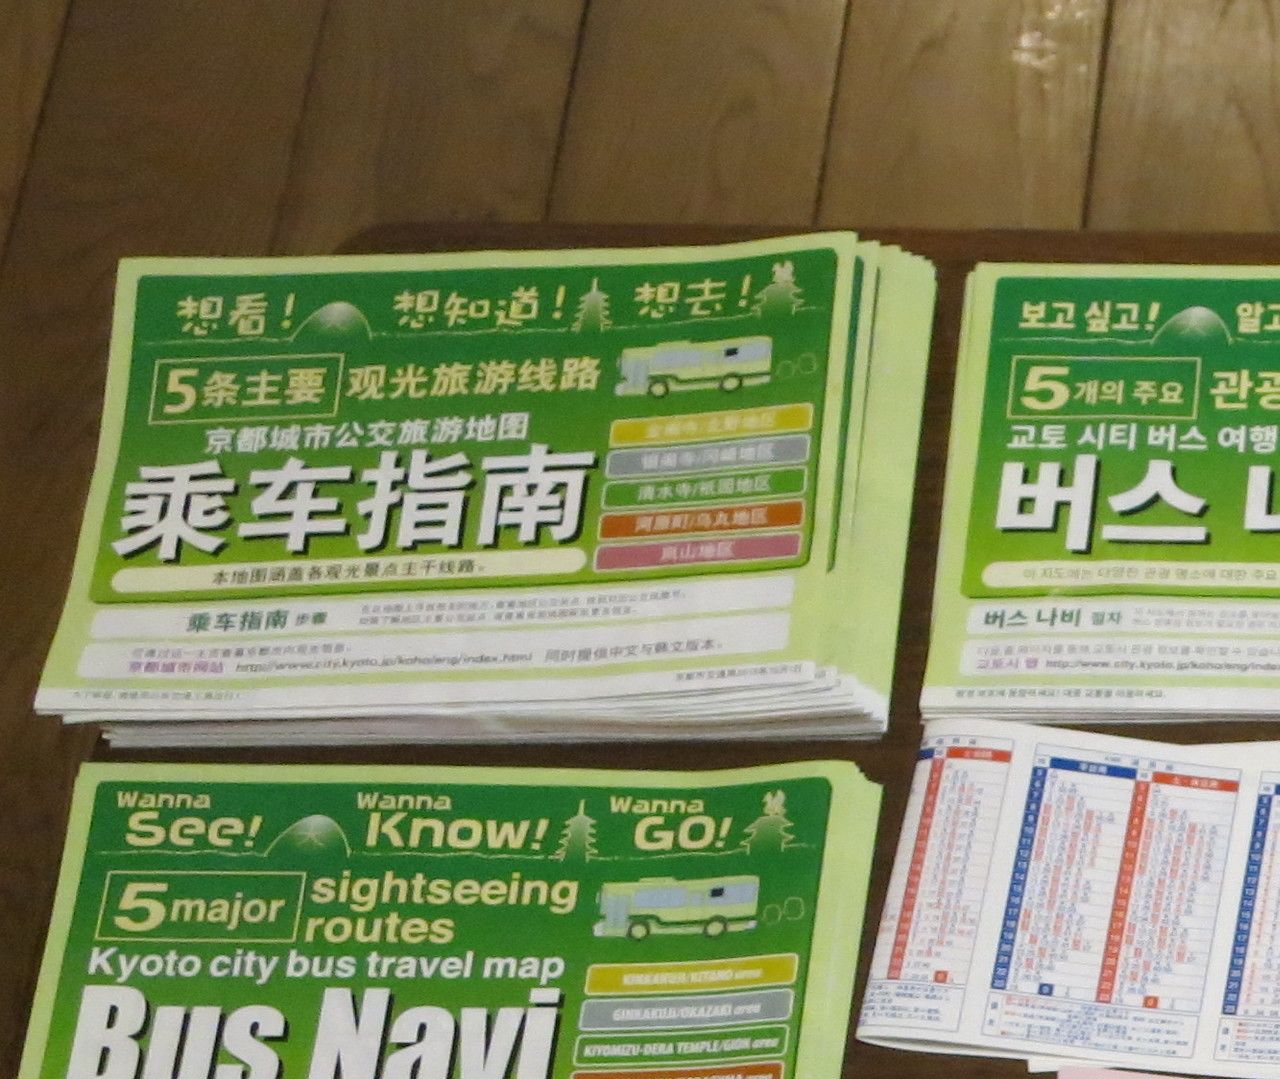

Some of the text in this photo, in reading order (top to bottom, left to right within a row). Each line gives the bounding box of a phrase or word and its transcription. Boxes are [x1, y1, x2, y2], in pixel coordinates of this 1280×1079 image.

[176, 279, 752, 339] 想看! 想知道! 想去!
[1019, 301, 1076, 332] 보고
[1084, 301, 1159, 333] 싶고!
[164, 357, 601, 414] 5条主要 观光旅游线路
[1021, 365, 1125, 411] 5개의
[1133, 379, 1185, 406] 주요
[205, 411, 531, 454] 京都城市公交旅游地图
[1007, 425, 1067, 450] 교토
[1079, 424, 1136, 450] 시티
[1148, 424, 1207, 452] 버스
[1218, 426, 1278, 454] 여행
[111, 443, 598, 564] 乘车指南
[996, 454, 1210, 554] 버스
[185, 607, 289, 633] 乘车指南
[984, 610, 1027, 627] 버스
[1037, 609, 1080, 628] 나비
[116, 790, 211, 810] Wanna
[355, 790, 451, 810] Wanna
[610, 796, 705, 814] Wanna
[125, 813, 263, 848] See!
[366, 813, 550, 850] Know!
[634, 816, 731, 849] GO!
[114, 881, 286, 932] 5 major
[311, 871, 579, 915] sightseeing
[304, 910, 456, 944] routes
[86, 947, 566, 986] Kyoto city bus travel map
